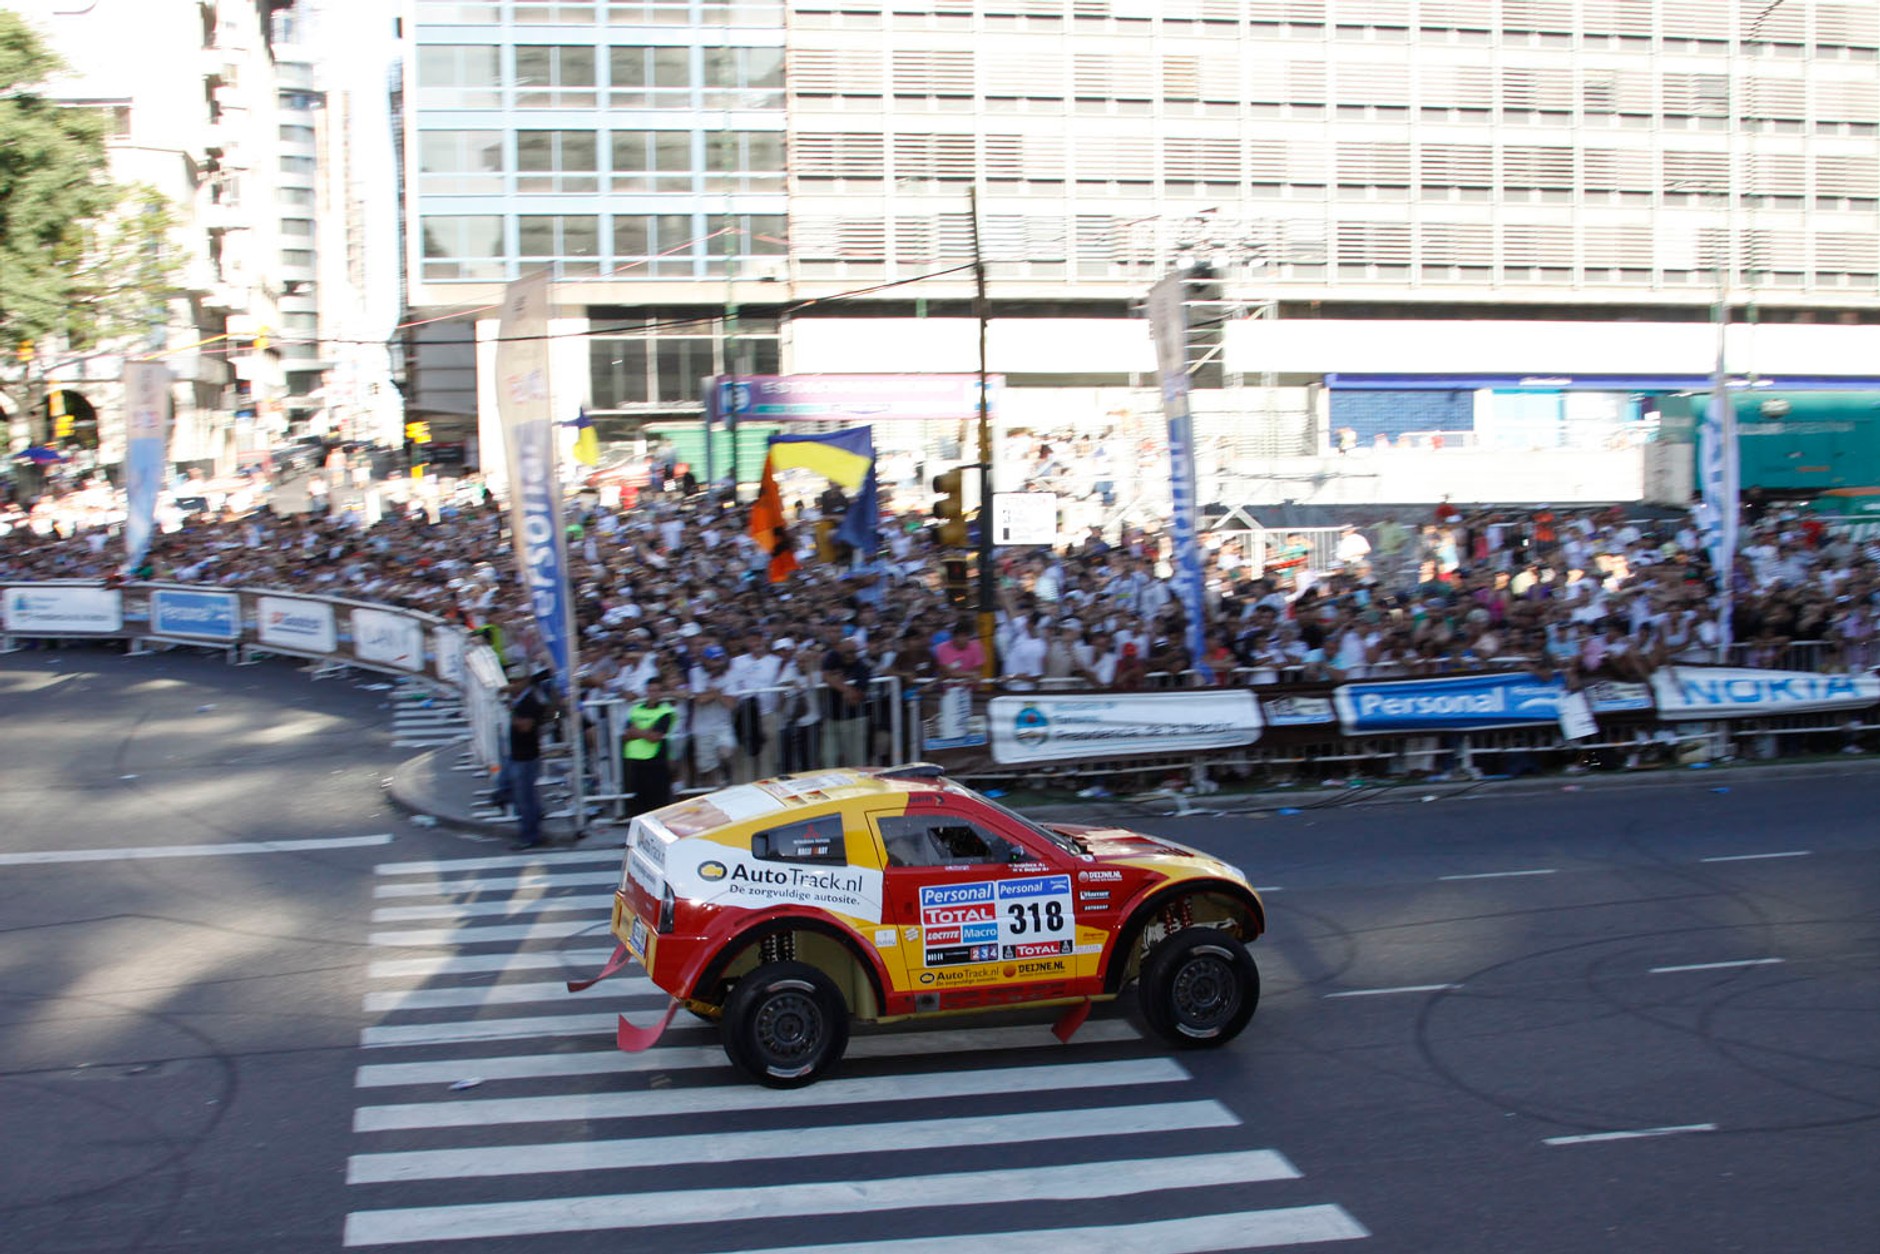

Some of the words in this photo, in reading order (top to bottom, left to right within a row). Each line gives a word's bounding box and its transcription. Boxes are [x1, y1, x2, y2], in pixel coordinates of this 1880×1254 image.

[1681, 678, 1862, 705] NOKIA
[1359, 686, 1505, 717] Personal
[731, 864, 863, 892] AutoTrack.nl
[729, 884, 746, 893] De
[748, 888, 812, 901] zorgvuldige
[814, 894, 860, 905] autosite.
[924, 884, 992, 904] Personal
[1000, 881, 1043, 895] Personal
[926, 907, 994, 925] TOTAL
[1008, 901, 1064, 935] 318
[927, 930, 960, 941] LOCTITE
[963, 927, 998, 939] Macro
[1016, 945, 1059, 956] TOTAL
[937, 966, 999, 981] AutoTrack.nl
[1018, 961, 1066, 973] DEIJNE.NL
